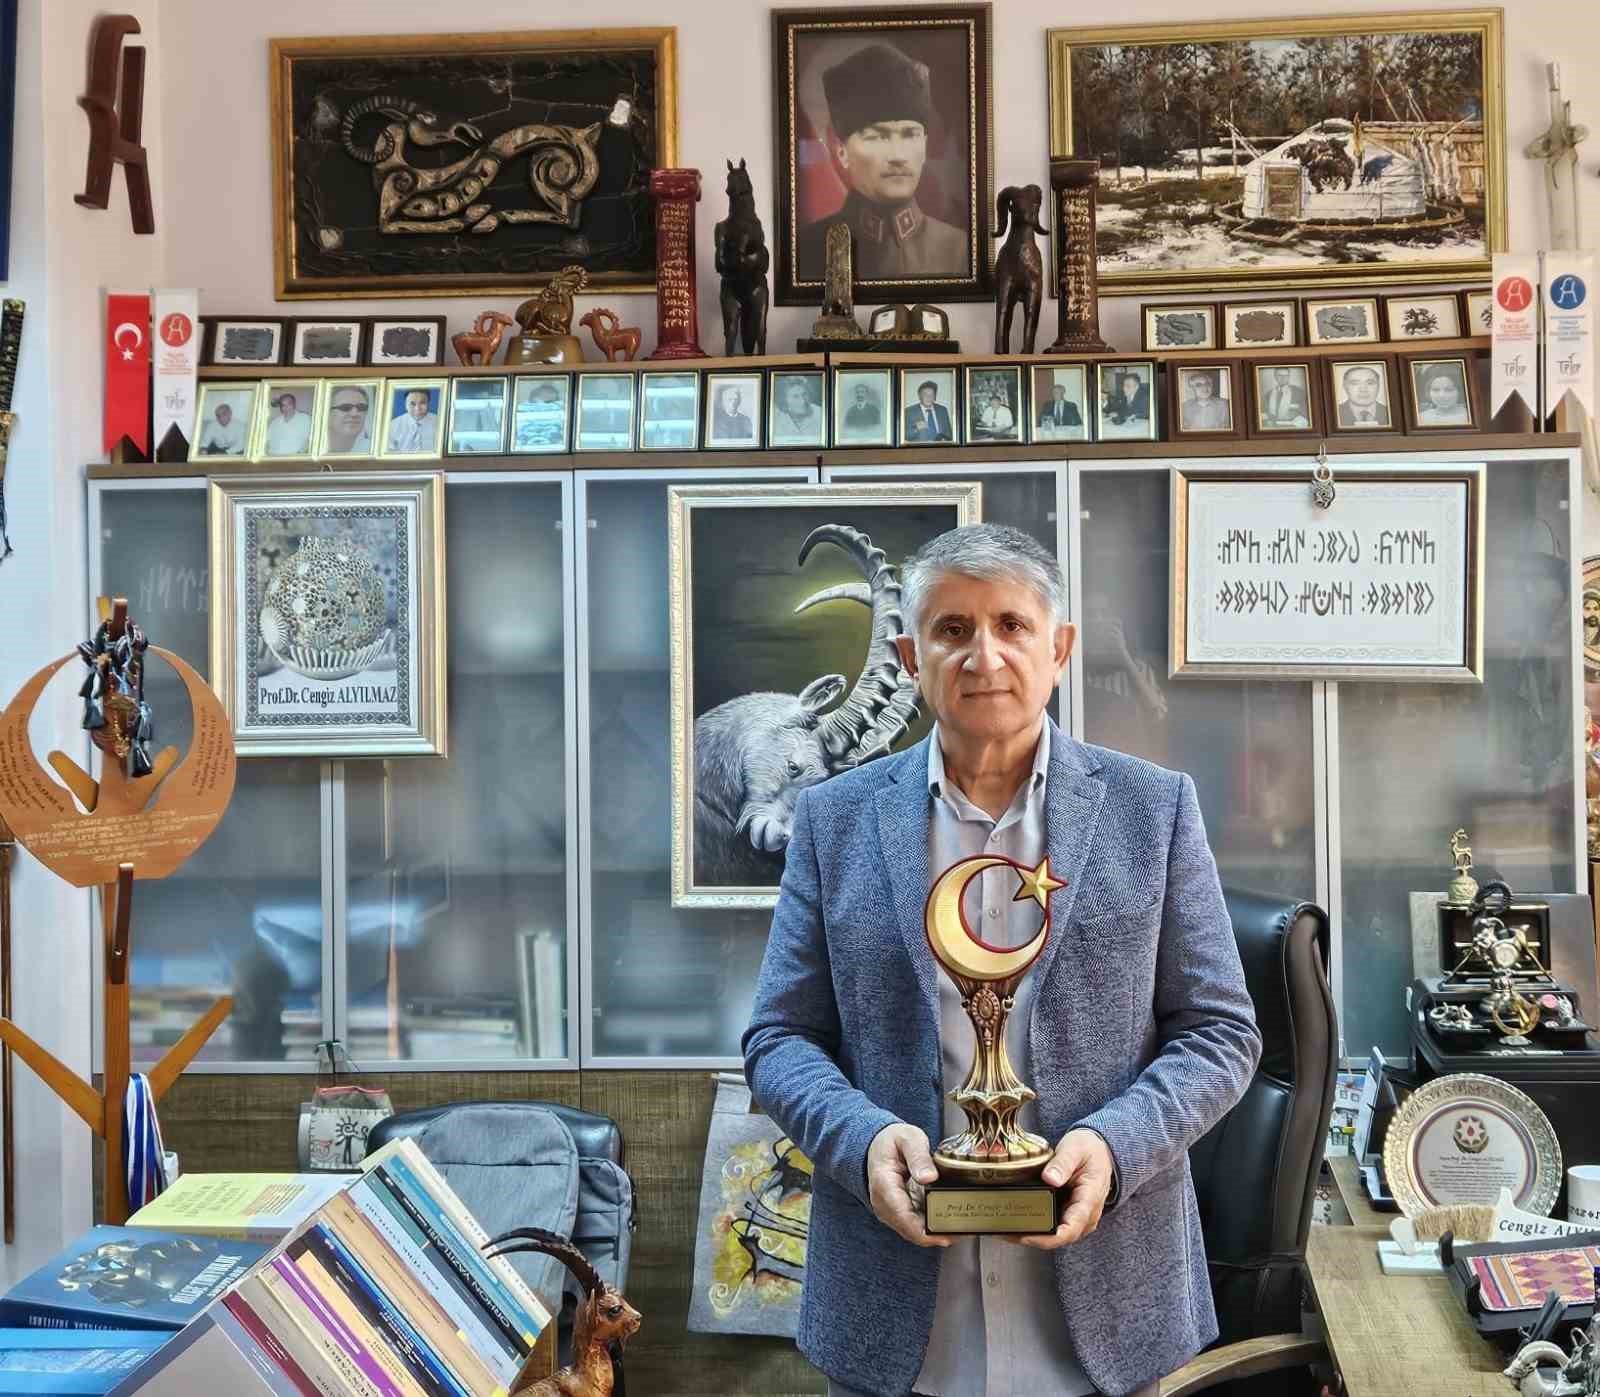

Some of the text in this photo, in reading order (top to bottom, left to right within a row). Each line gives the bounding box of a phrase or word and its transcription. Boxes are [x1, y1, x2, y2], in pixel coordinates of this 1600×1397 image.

[301, 686, 336, 709] Cengiz
[337, 685, 398, 704] ALYILMAZ
[1499, 1219, 1548, 1237] Cengiz
[471, 1280, 512, 1328] ORHON
